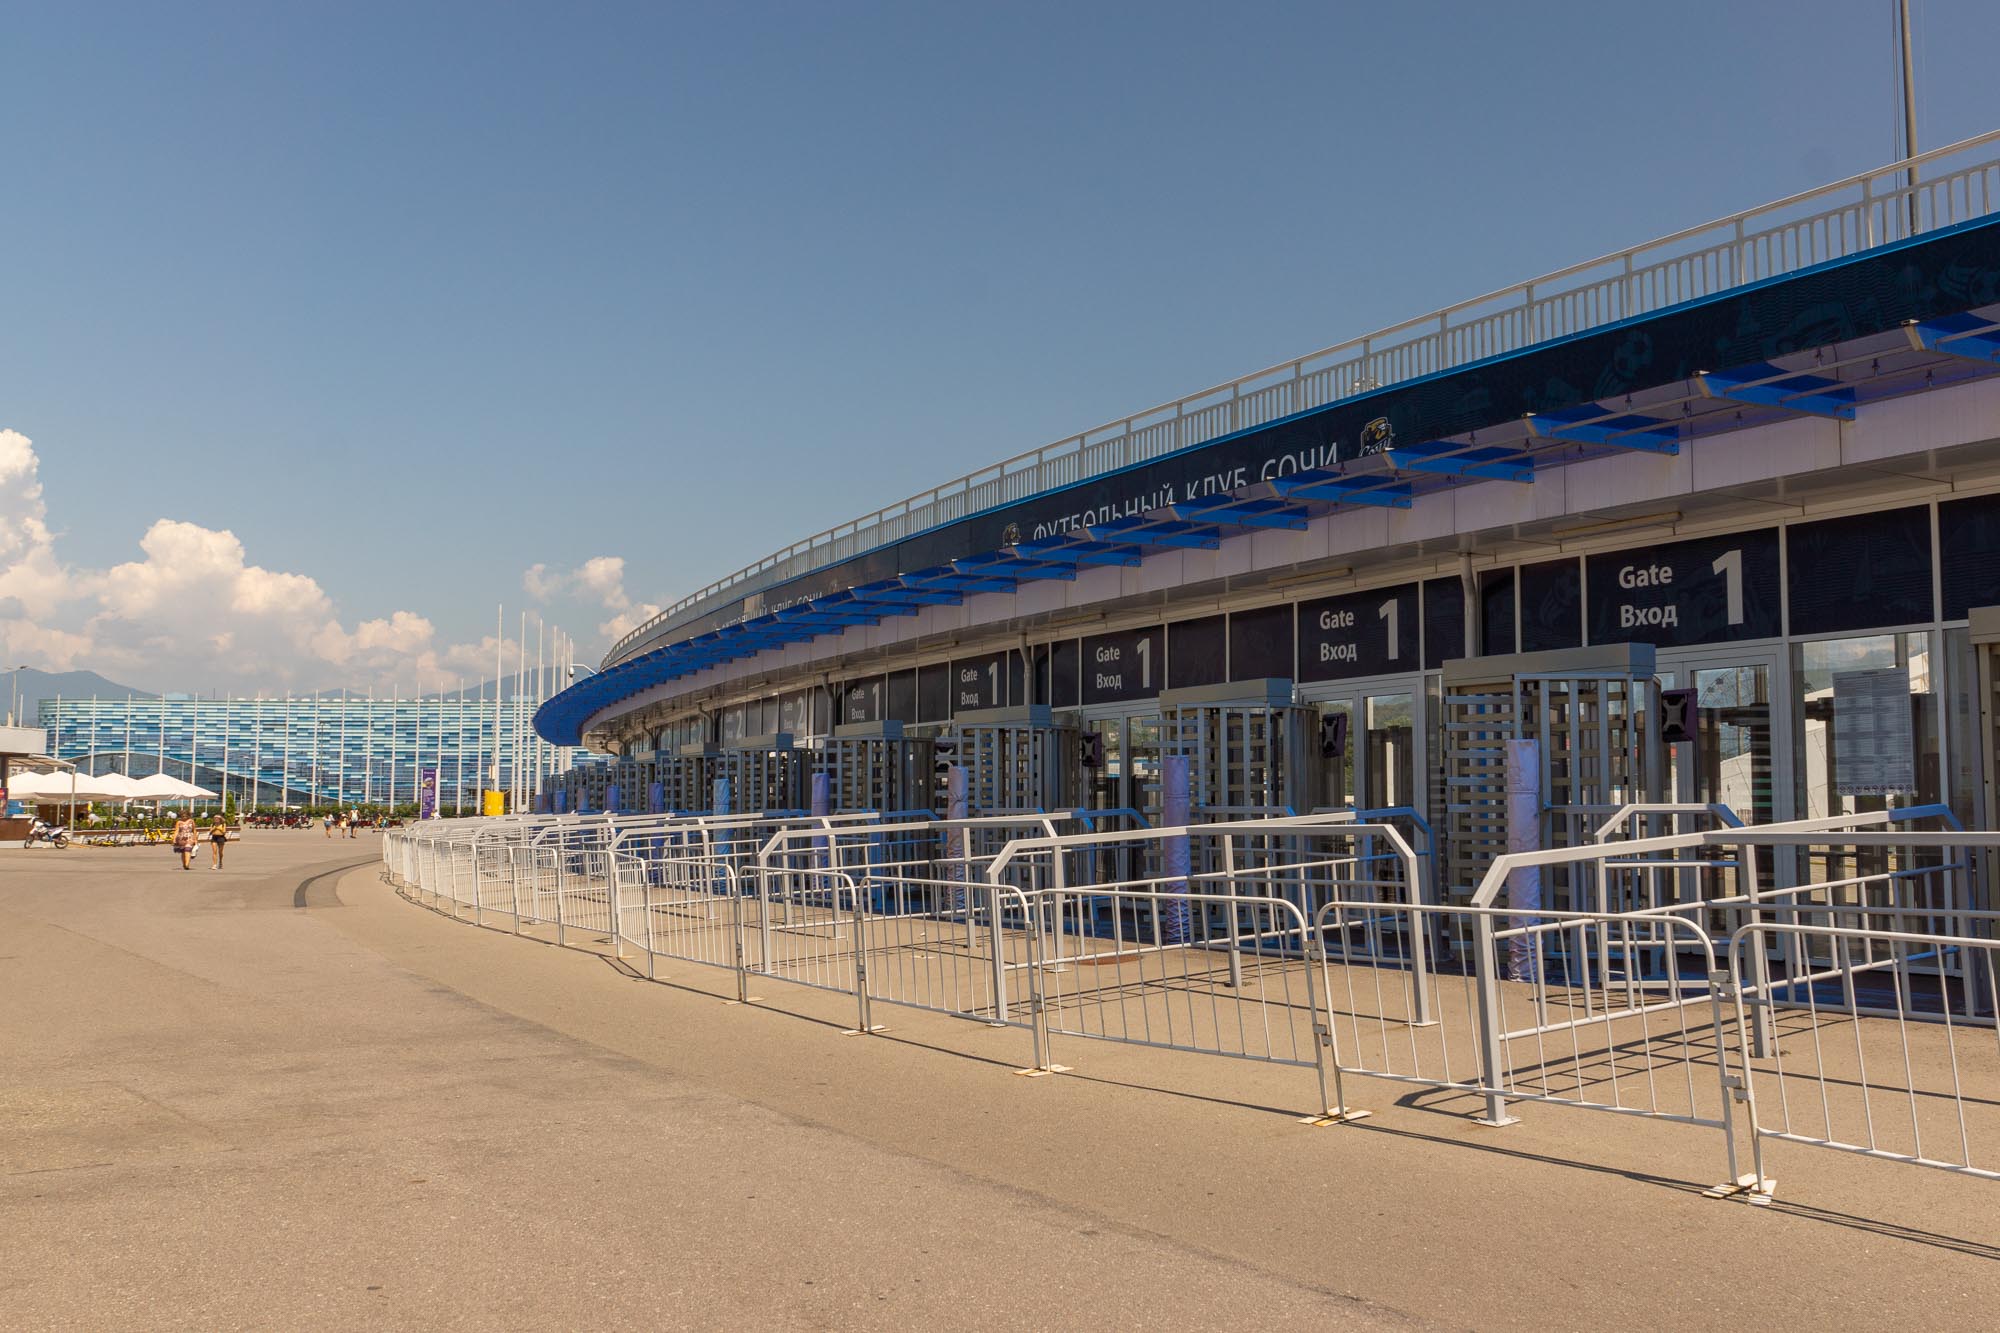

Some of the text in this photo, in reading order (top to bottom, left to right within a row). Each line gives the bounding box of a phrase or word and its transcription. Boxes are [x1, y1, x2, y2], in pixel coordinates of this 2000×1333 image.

[1618, 564, 1673, 589] Gate
[1712, 549, 1744, 625] 1
[1320, 609, 1355, 630] Gate
[1620, 605, 1678, 629] Вход
[1379, 598, 1399, 660] 1
[1096, 646, 1120, 663] Gate
[1137, 638, 1150, 689] 1
[1320, 642, 1358, 663] Вход
[961, 668, 978, 683] Gate
[988, 661, 998, 705] 1
[1096, 673, 1122, 690] Вход
[851, 688, 865, 700] Gate
[872, 683, 880, 721] 1
[961, 692, 979, 706] Вход
[797, 696, 804, 731] 2
[851, 708, 865, 721] Вход
